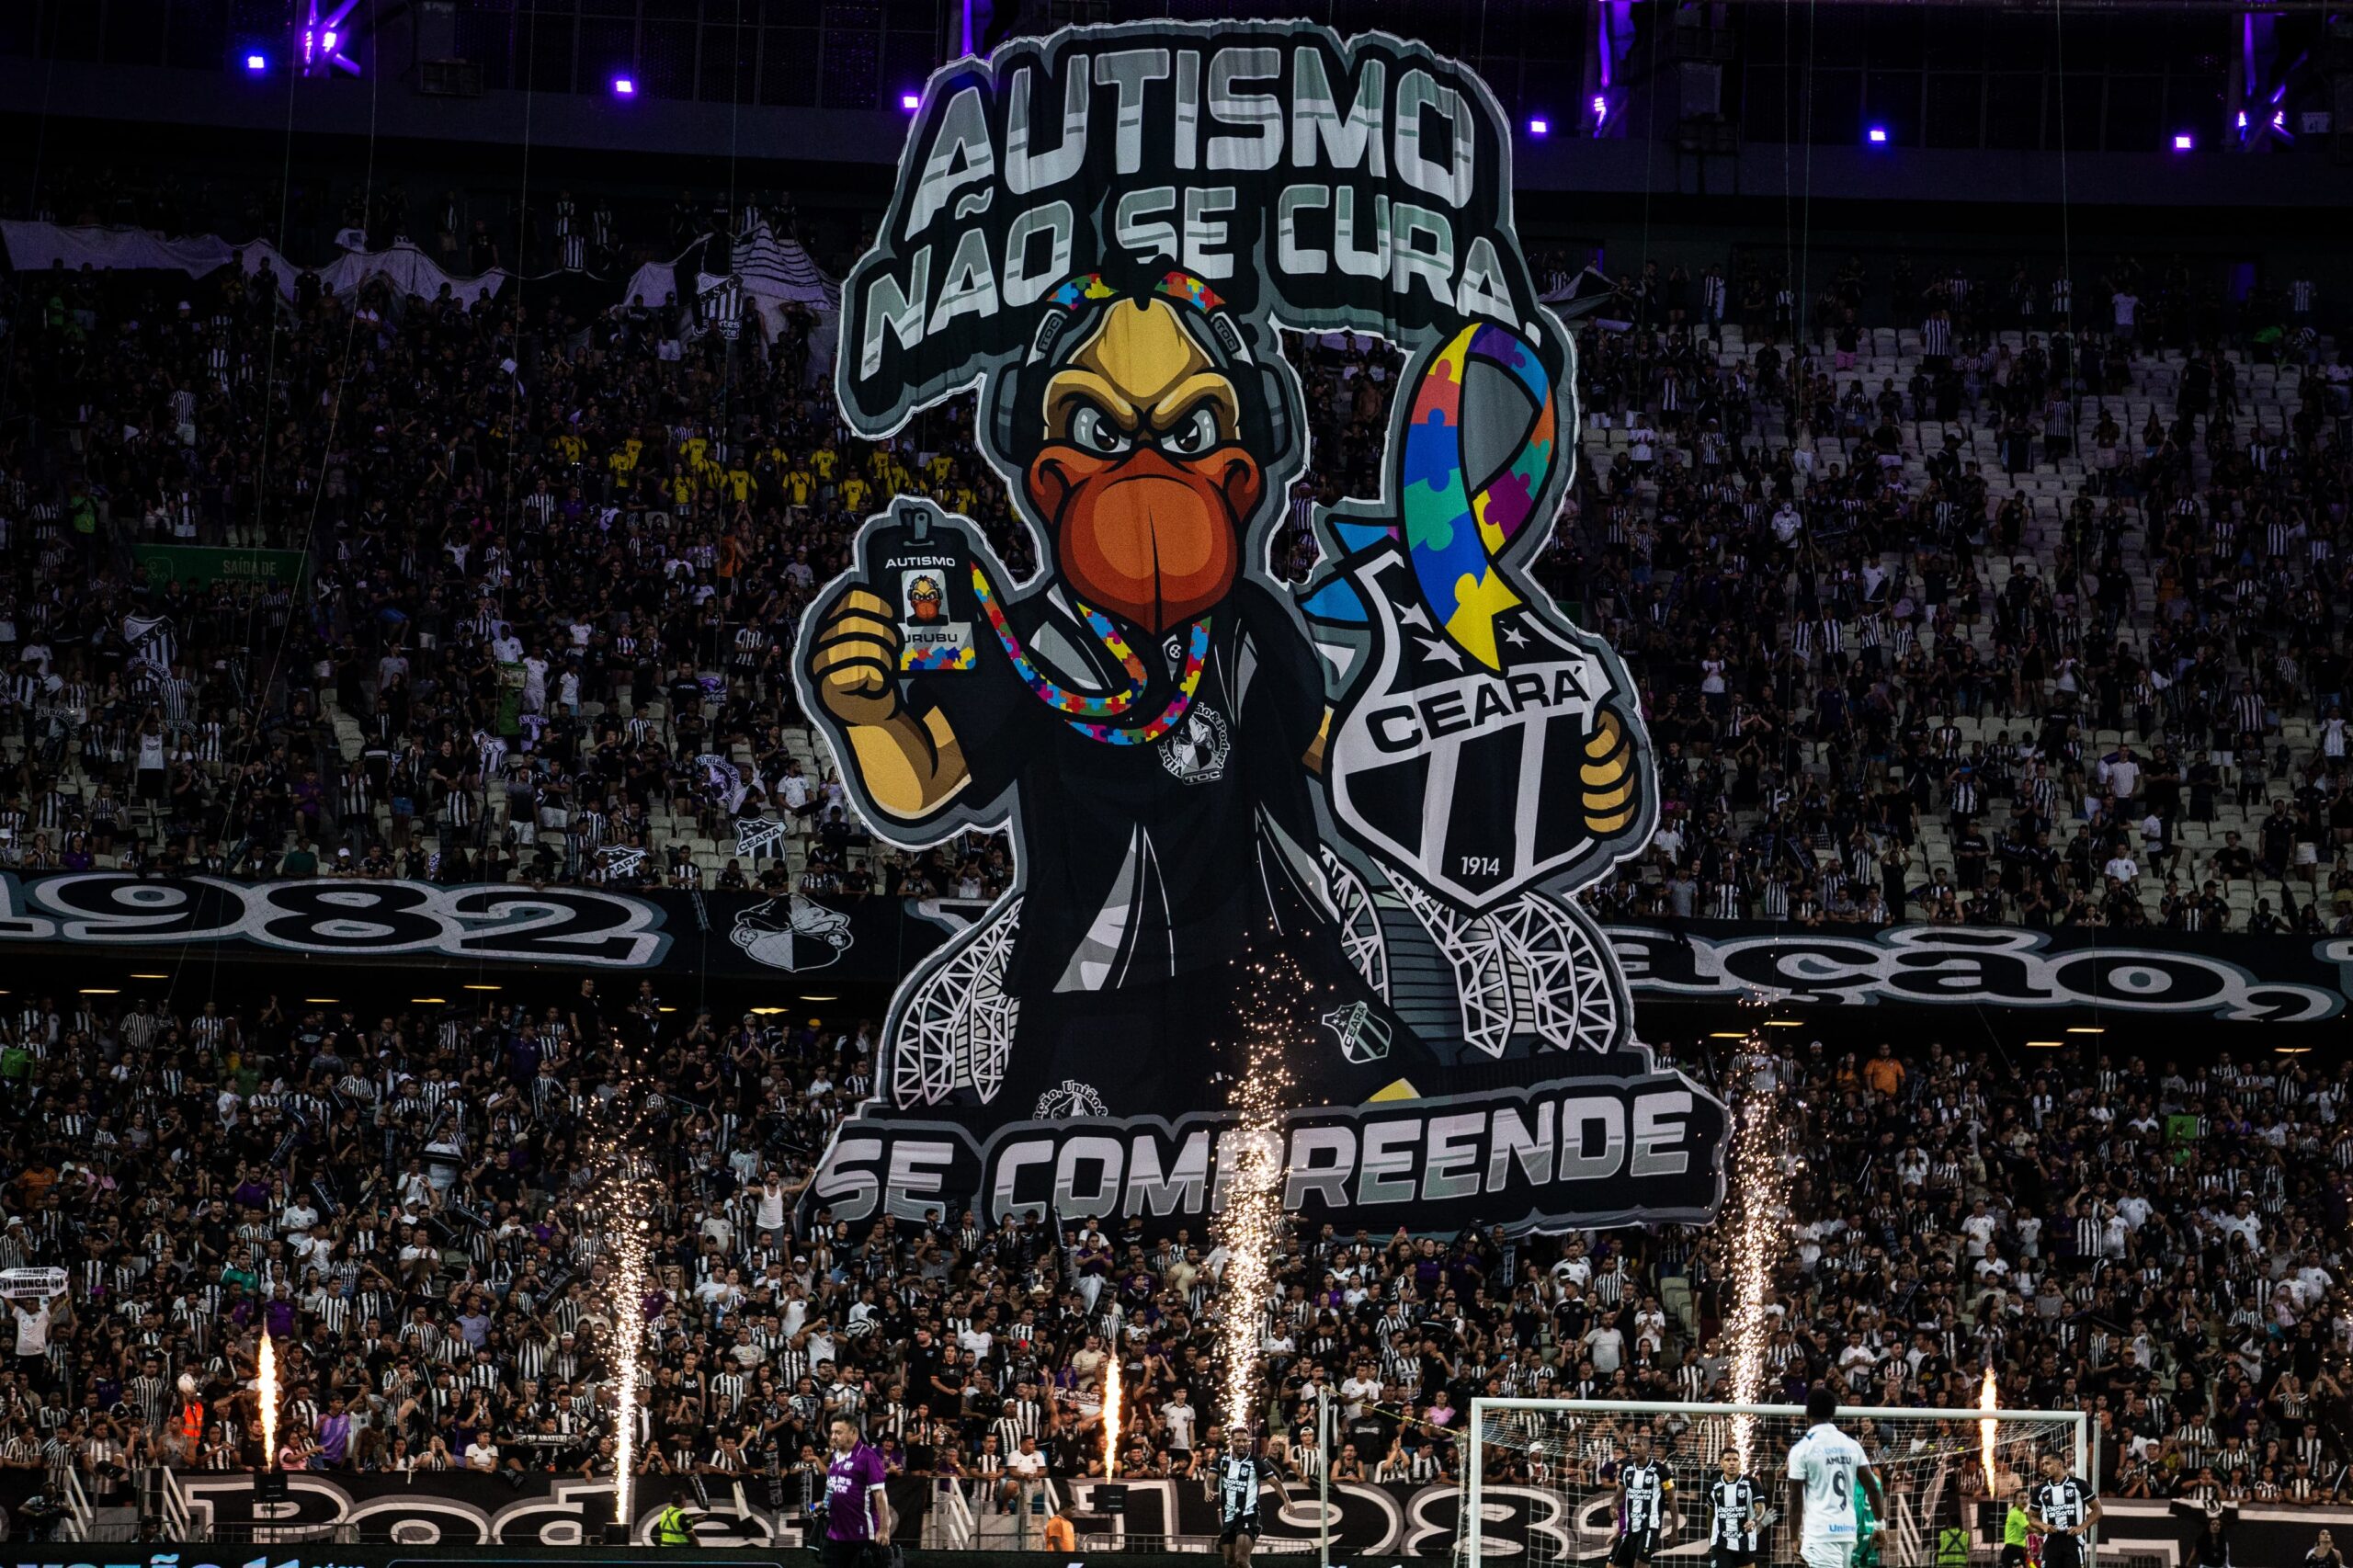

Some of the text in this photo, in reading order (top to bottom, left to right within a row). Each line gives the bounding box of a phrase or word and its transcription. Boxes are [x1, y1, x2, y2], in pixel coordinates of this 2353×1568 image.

[904, 45, 1474, 242] AUTISMO
[860, 187, 1074, 381] NÃO
[1116, 187, 1237, 279] SE
[1040, 316, 1063, 348] TOC
[1217, 323, 1237, 349] TOC
[223, 557, 277, 575] SAÍDA DE
[885, 556, 956, 569] AUTISMO
[1364, 665, 1591, 754] CEARÁ
[1185, 771, 1221, 783] TOC
[1461, 856, 1501, 876] 1914
[815, 1090, 1694, 1228] SE COMPREENDE
[14, 1278, 49, 1288] NUNCA
[1825, 1456, 1852, 1465] AMUZU
[1833, 1471, 1847, 1511] 9
[1718, 1506, 1746, 1514] Esportes
[1829, 1524, 1856, 1532] Unime
